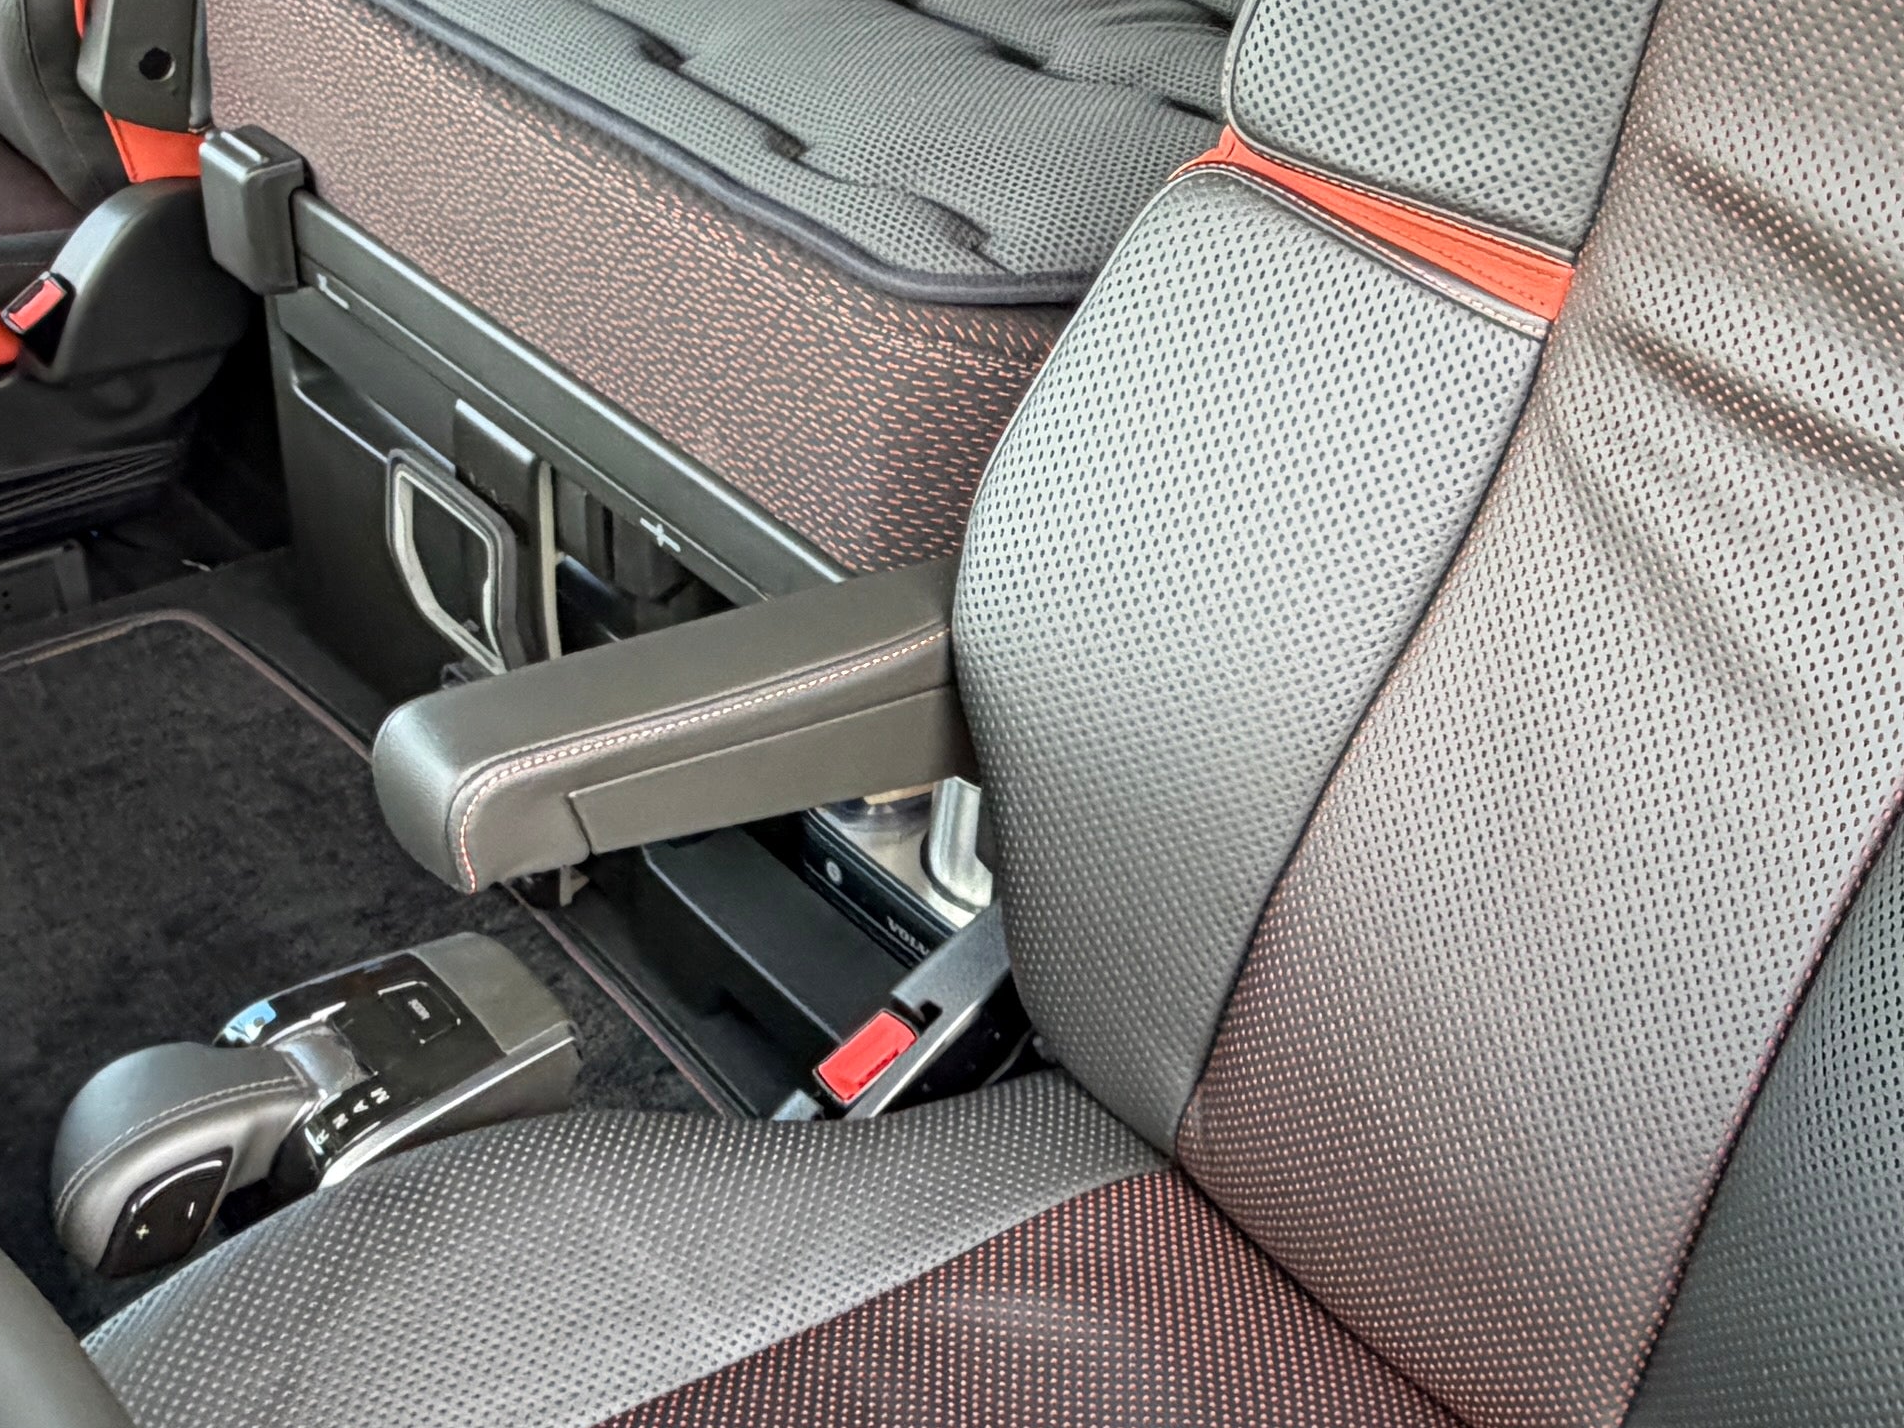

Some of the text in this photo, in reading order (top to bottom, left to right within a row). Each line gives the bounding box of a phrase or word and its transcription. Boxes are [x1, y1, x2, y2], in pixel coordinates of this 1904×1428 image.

[886, 915, 930, 956] VOLV
[370, 1086, 390, 1105] M
[353, 1098, 369, 1114] A
[332, 1112, 349, 1130] N
[315, 1128, 330, 1146] R
